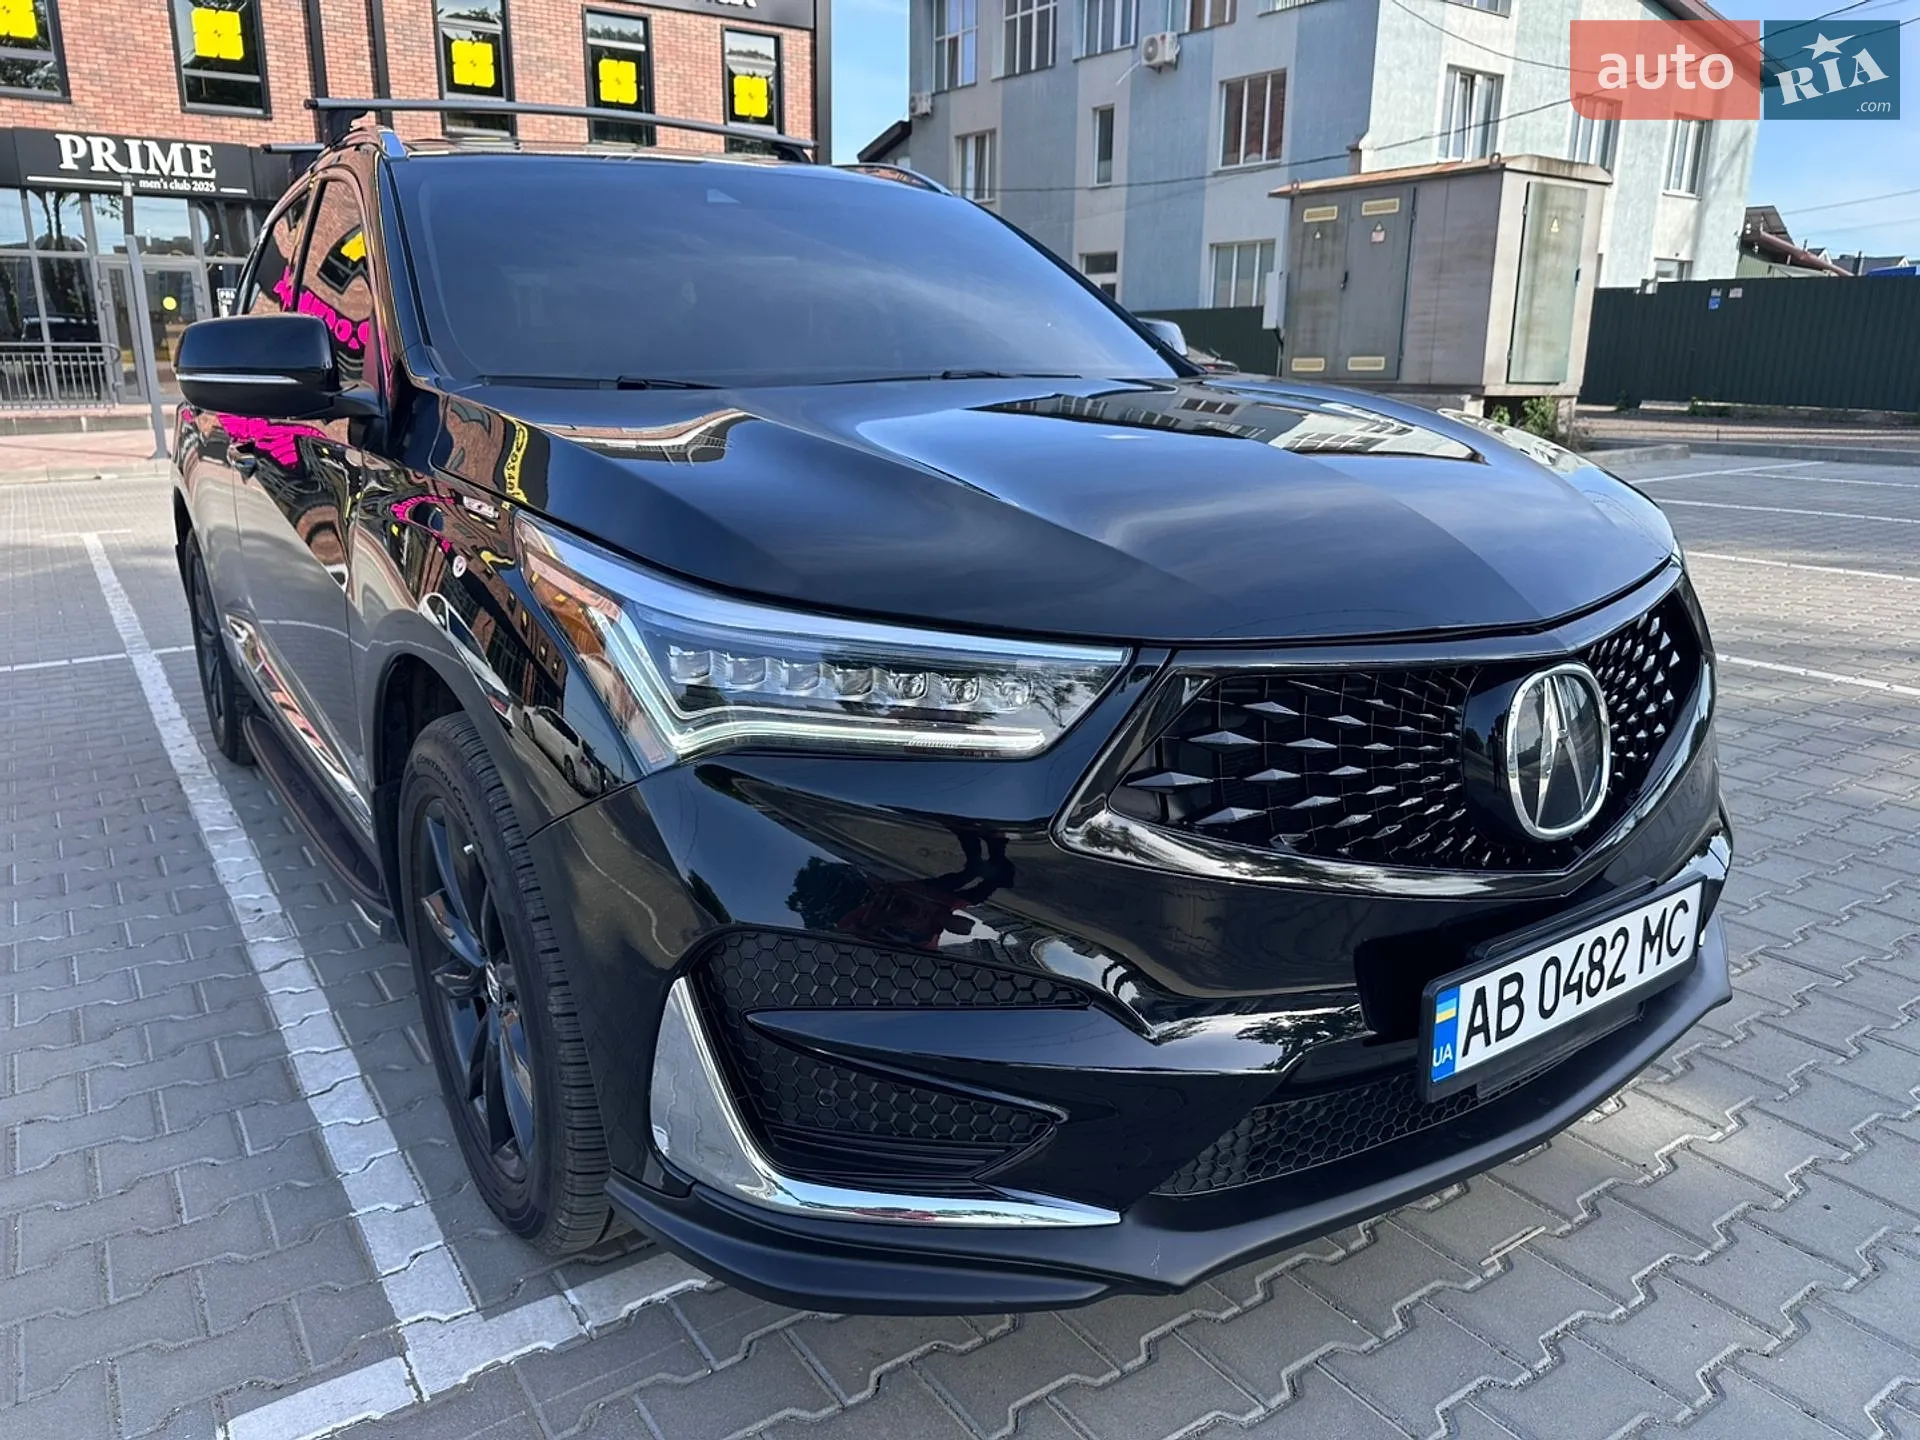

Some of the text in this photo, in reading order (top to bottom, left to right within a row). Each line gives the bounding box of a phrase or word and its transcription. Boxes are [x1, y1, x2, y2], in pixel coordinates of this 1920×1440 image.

[55, 133, 216, 179] PRIME
[139, 178, 168, 189] men's
[169, 179, 191, 190] club
[1461, 899, 1689, 1058] AB 0482 MC
[1432, 1042, 1453, 1067] UA
